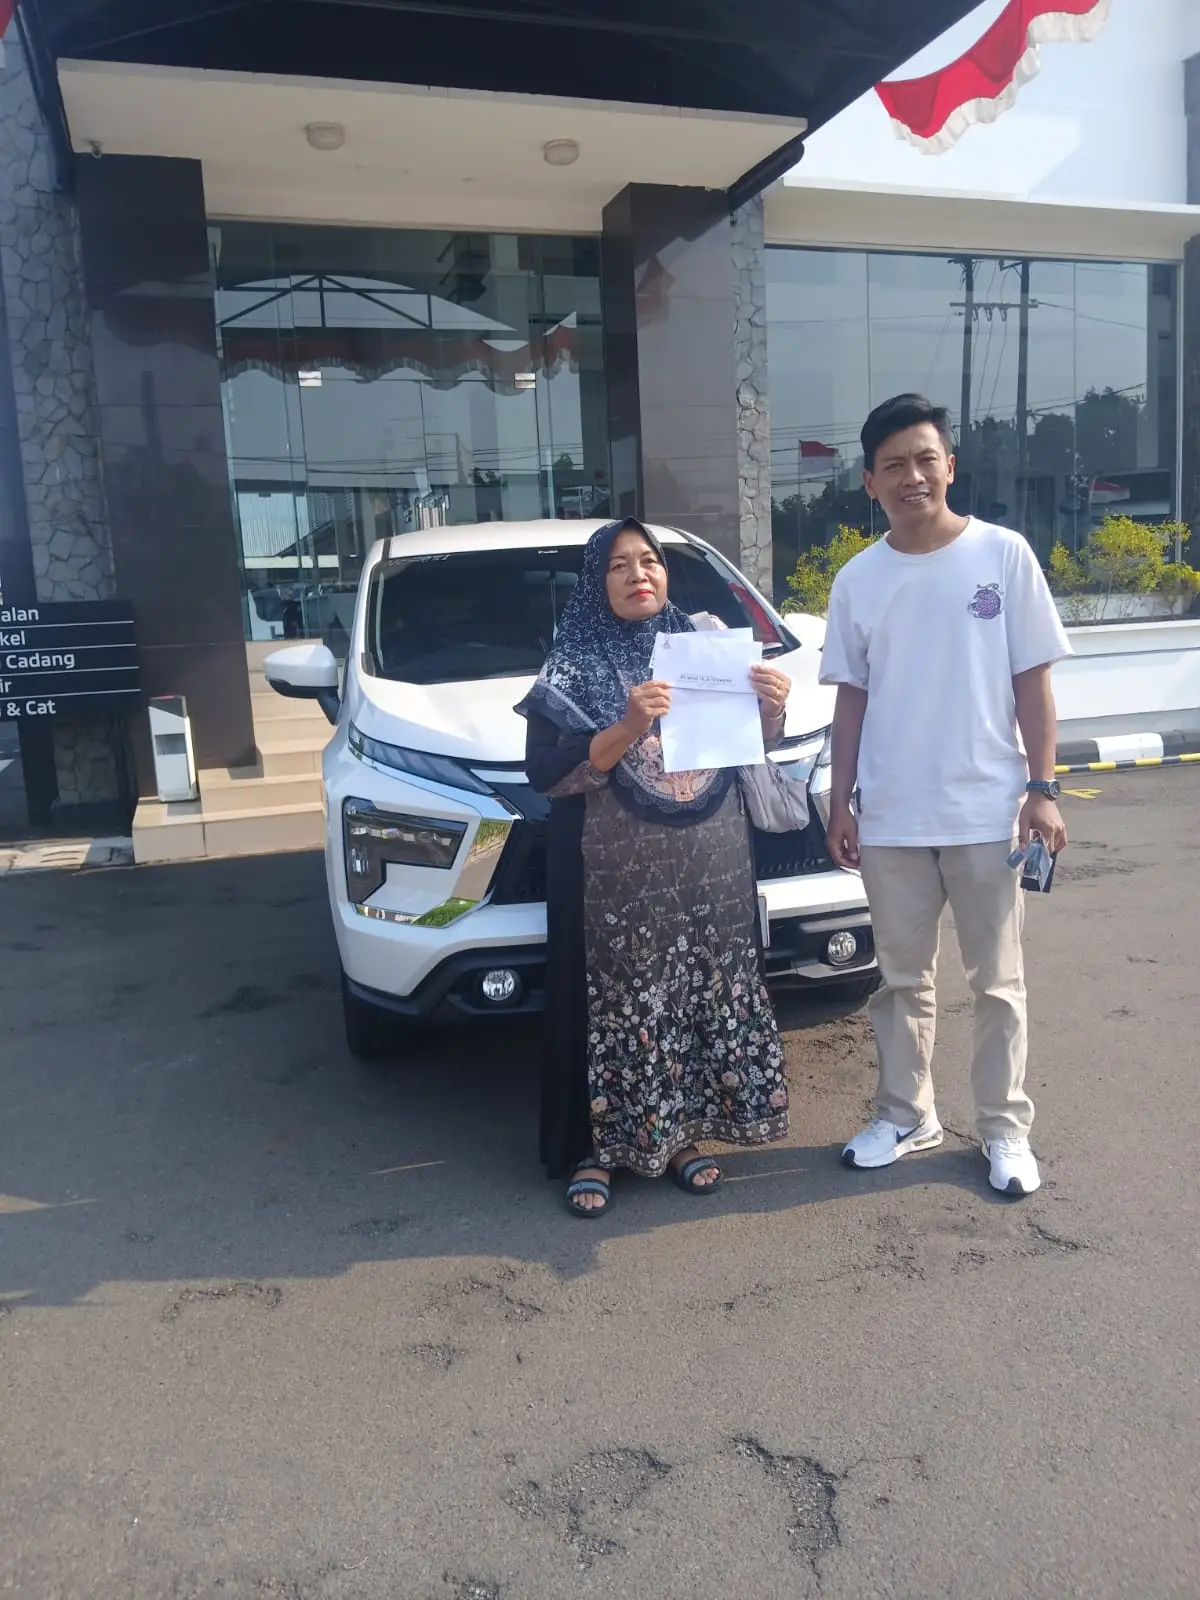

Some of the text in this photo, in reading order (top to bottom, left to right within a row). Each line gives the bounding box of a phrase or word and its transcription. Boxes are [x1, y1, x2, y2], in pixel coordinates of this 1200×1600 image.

[6, 652, 75, 668] Cadang
[7, 700, 56, 716] & Cat
